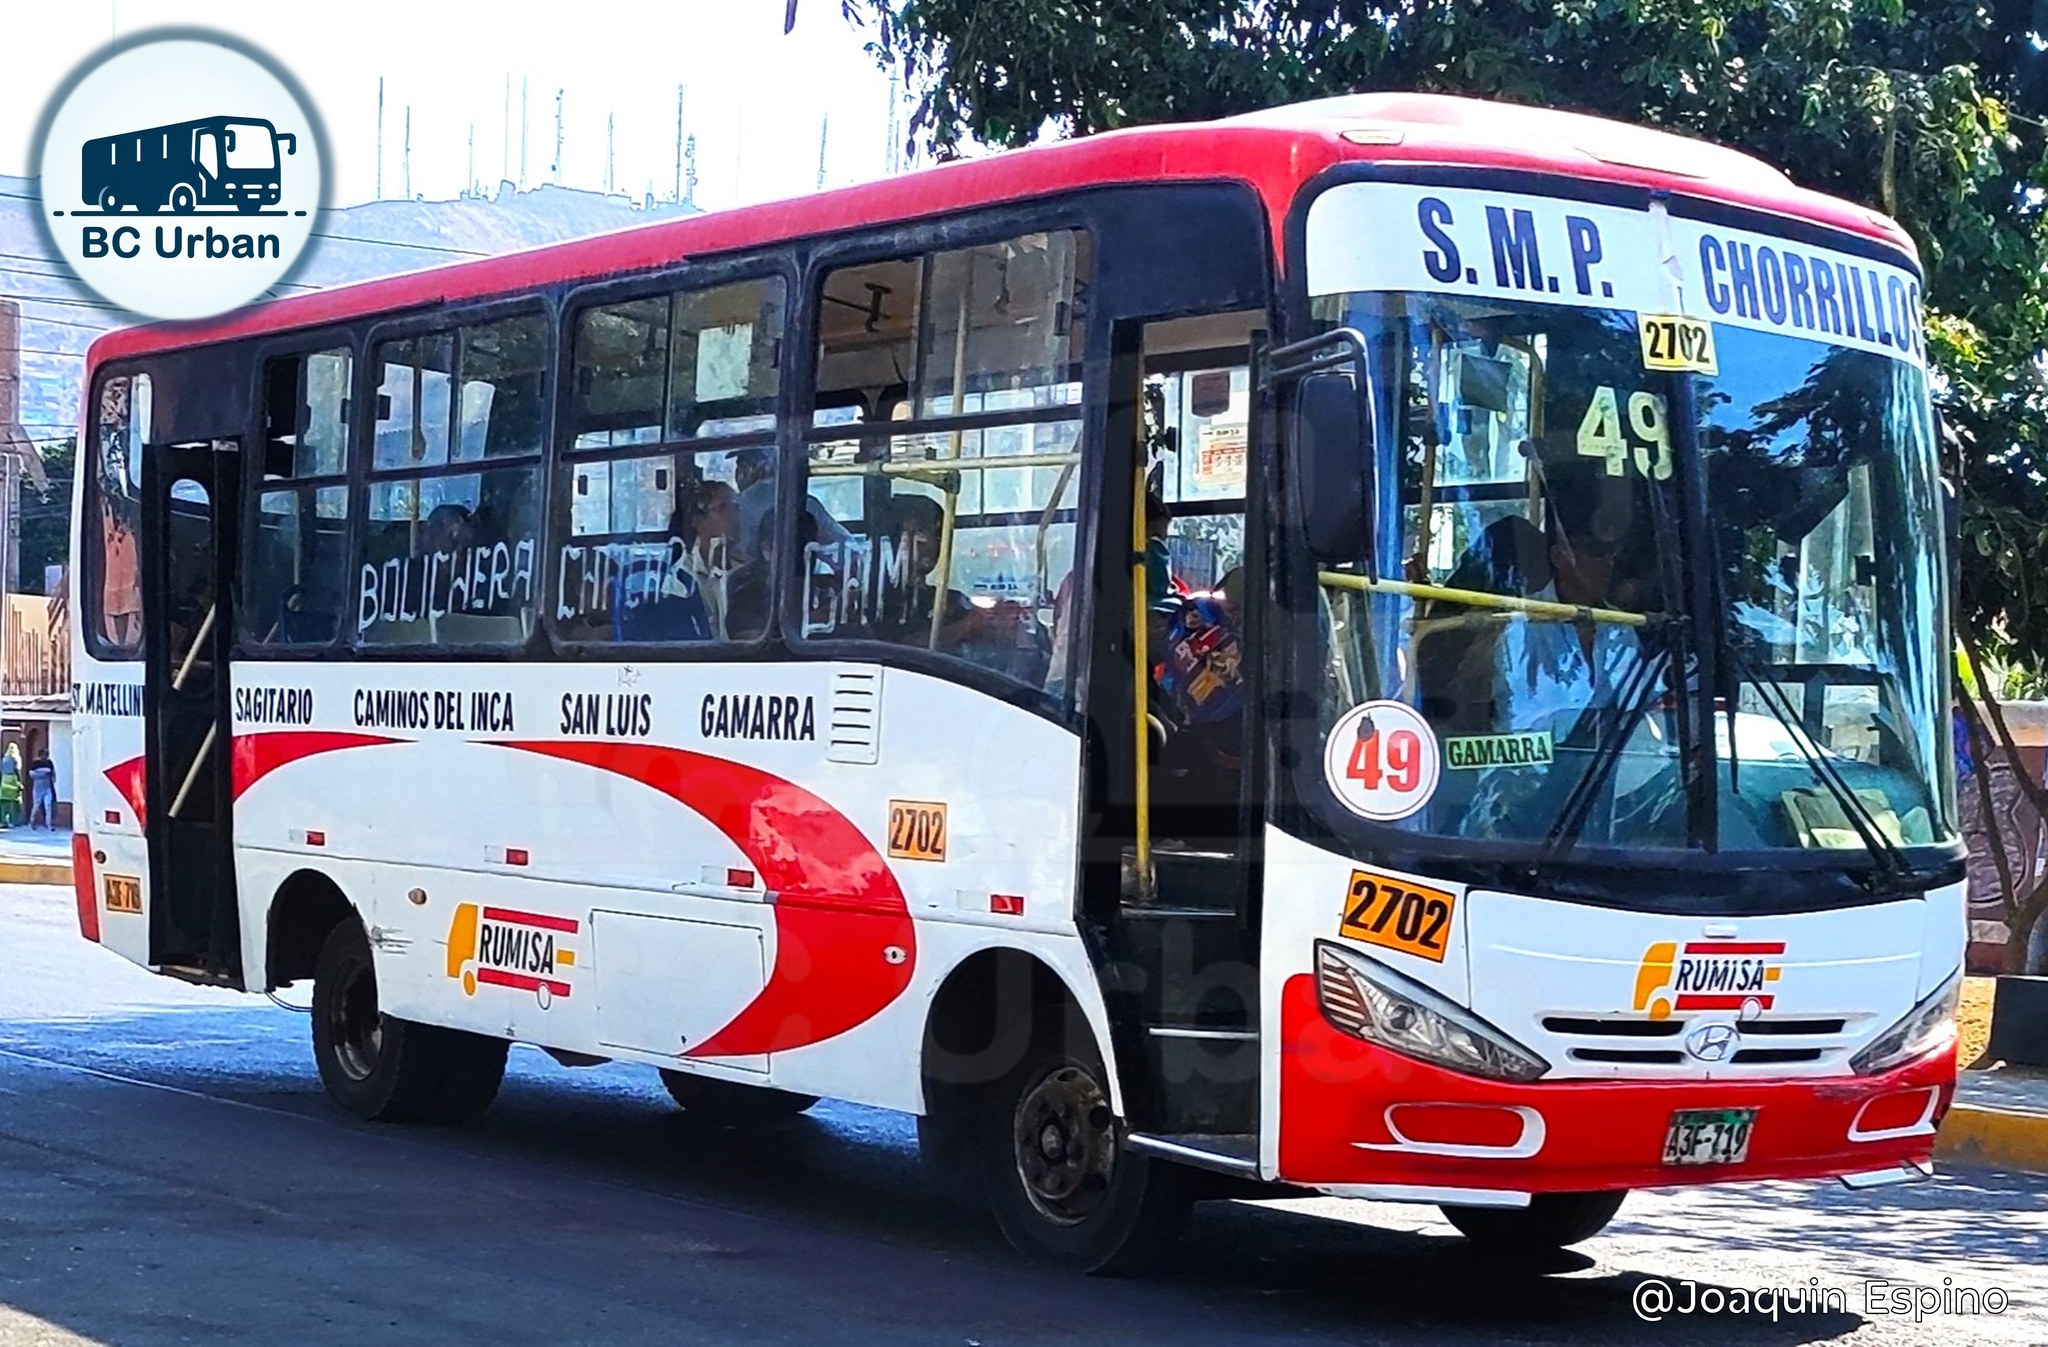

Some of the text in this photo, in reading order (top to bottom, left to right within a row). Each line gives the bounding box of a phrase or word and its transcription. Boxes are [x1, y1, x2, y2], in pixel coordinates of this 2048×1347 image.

[1417, 196, 1615, 298] S.M.P.
[1645, 320, 1711, 364] 2702
[1576, 385, 1673, 481] 49
[235, 687, 314, 725] SAGITARIO
[353, 688, 515, 732] CAMINOS DEL INCA
[560, 692, 652, 737] SAN LUIS
[700, 693, 816, 741] GAMARRA
[1345, 729, 1422, 793] 49
[1447, 735, 1551, 769] GAMARRA
[890, 807, 944, 855] 2702
[1344, 879, 1449, 950] 2702
[479, 923, 554, 975] RUMISA
[1674, 958, 1766, 992] RUMISA
